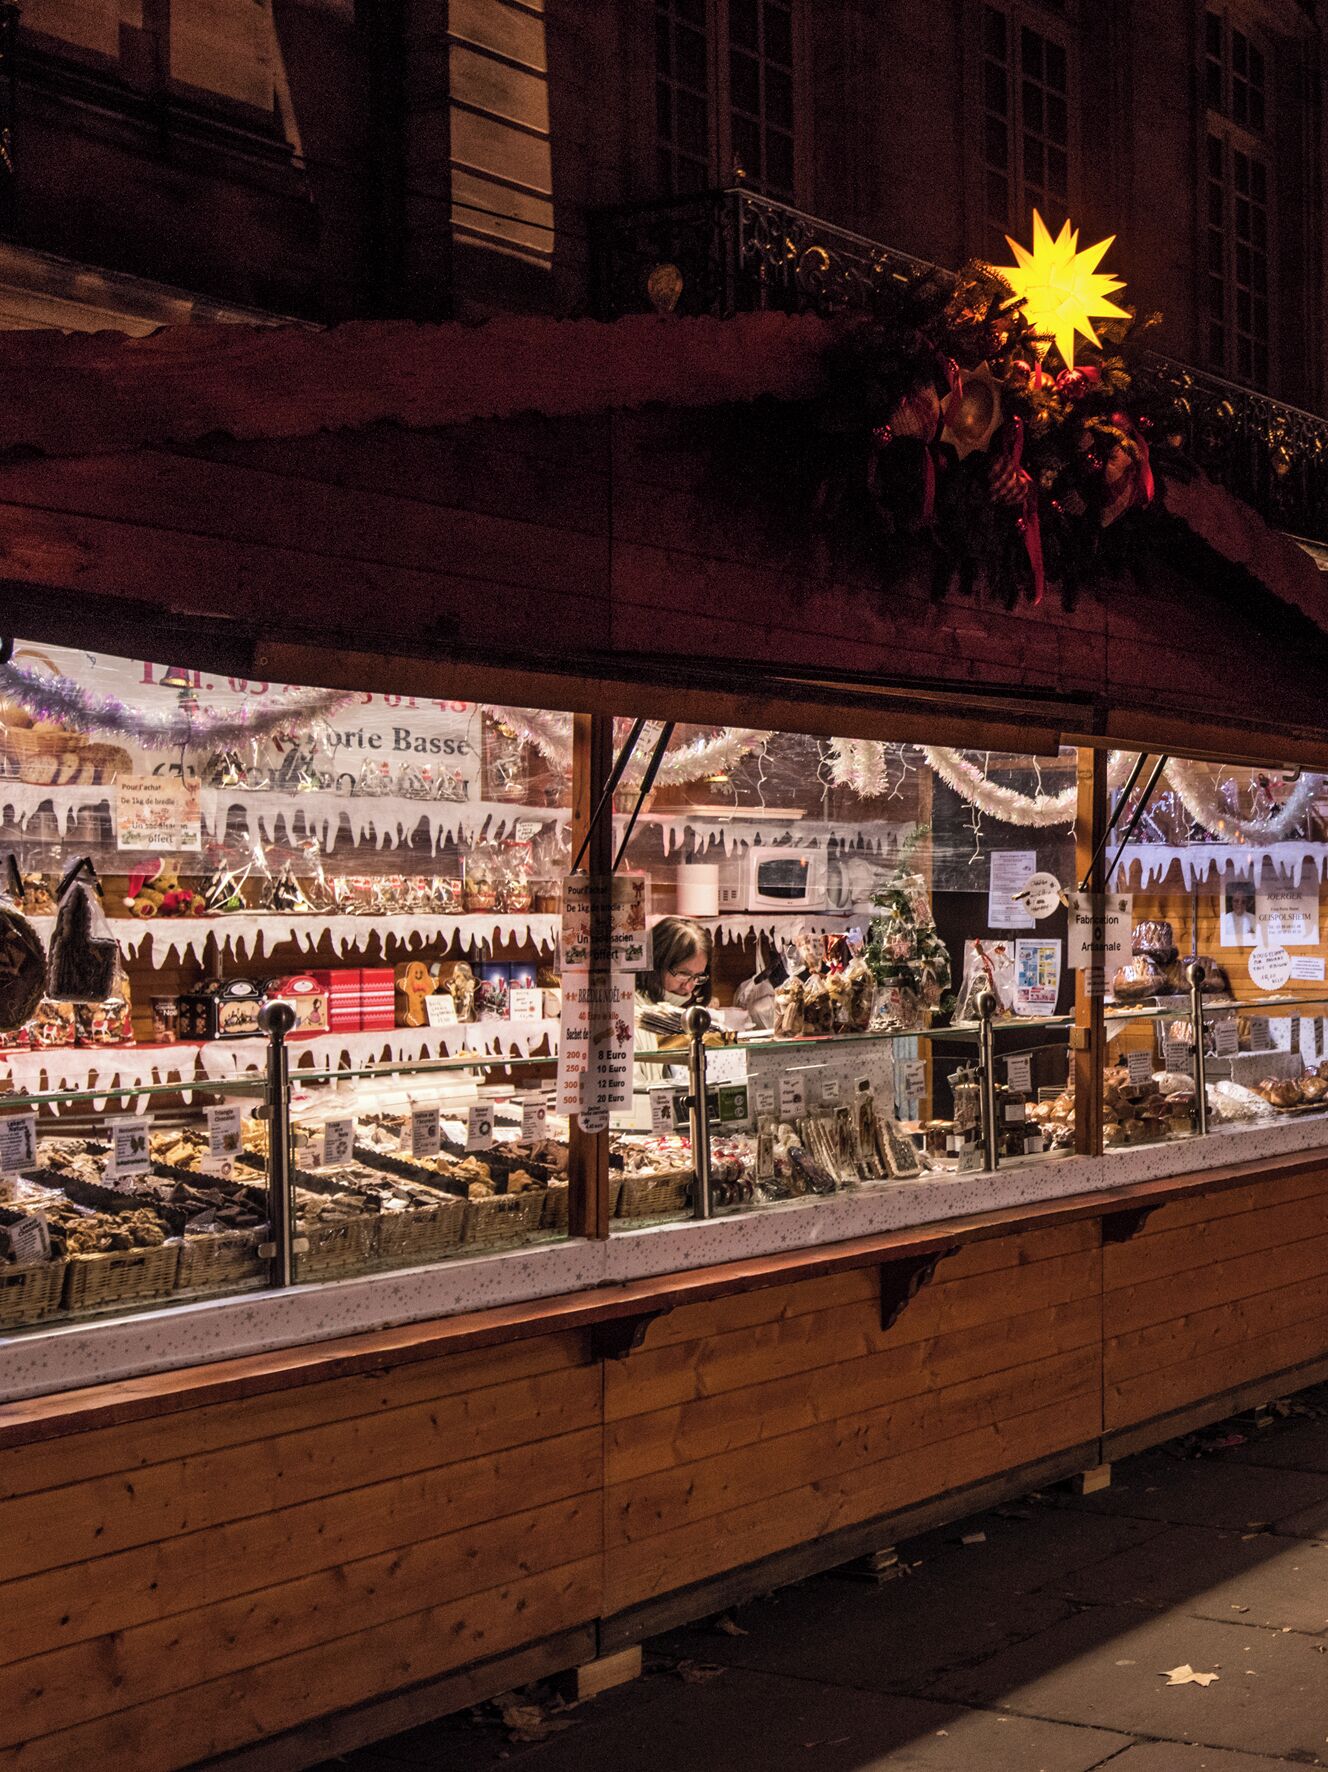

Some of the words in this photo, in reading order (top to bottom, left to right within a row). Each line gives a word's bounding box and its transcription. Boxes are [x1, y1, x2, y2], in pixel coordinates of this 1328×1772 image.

[307, 723, 382, 750] orte
[392, 727, 471, 756] Basse
[568, 886, 584, 895] Pour
[567, 904, 576, 913] De
[578, 904, 590, 914] 1kg
[1259, 912, 1311, 921] GEISPOLSHEIM
[577, 934, 588, 943] Un
[567, 1051, 580, 1059] 200
[606, 1050, 626, 1060] Euro
[597, 1065, 607, 1073] 10
[608, 1065, 626, 1073] Euro
[564, 1081, 578, 1089] 300
[597, 1080, 607, 1088] 12
[608, 1080, 625, 1088] Euro
[597, 1095, 607, 1103] 20
[608, 1094, 624, 1103] Euro
